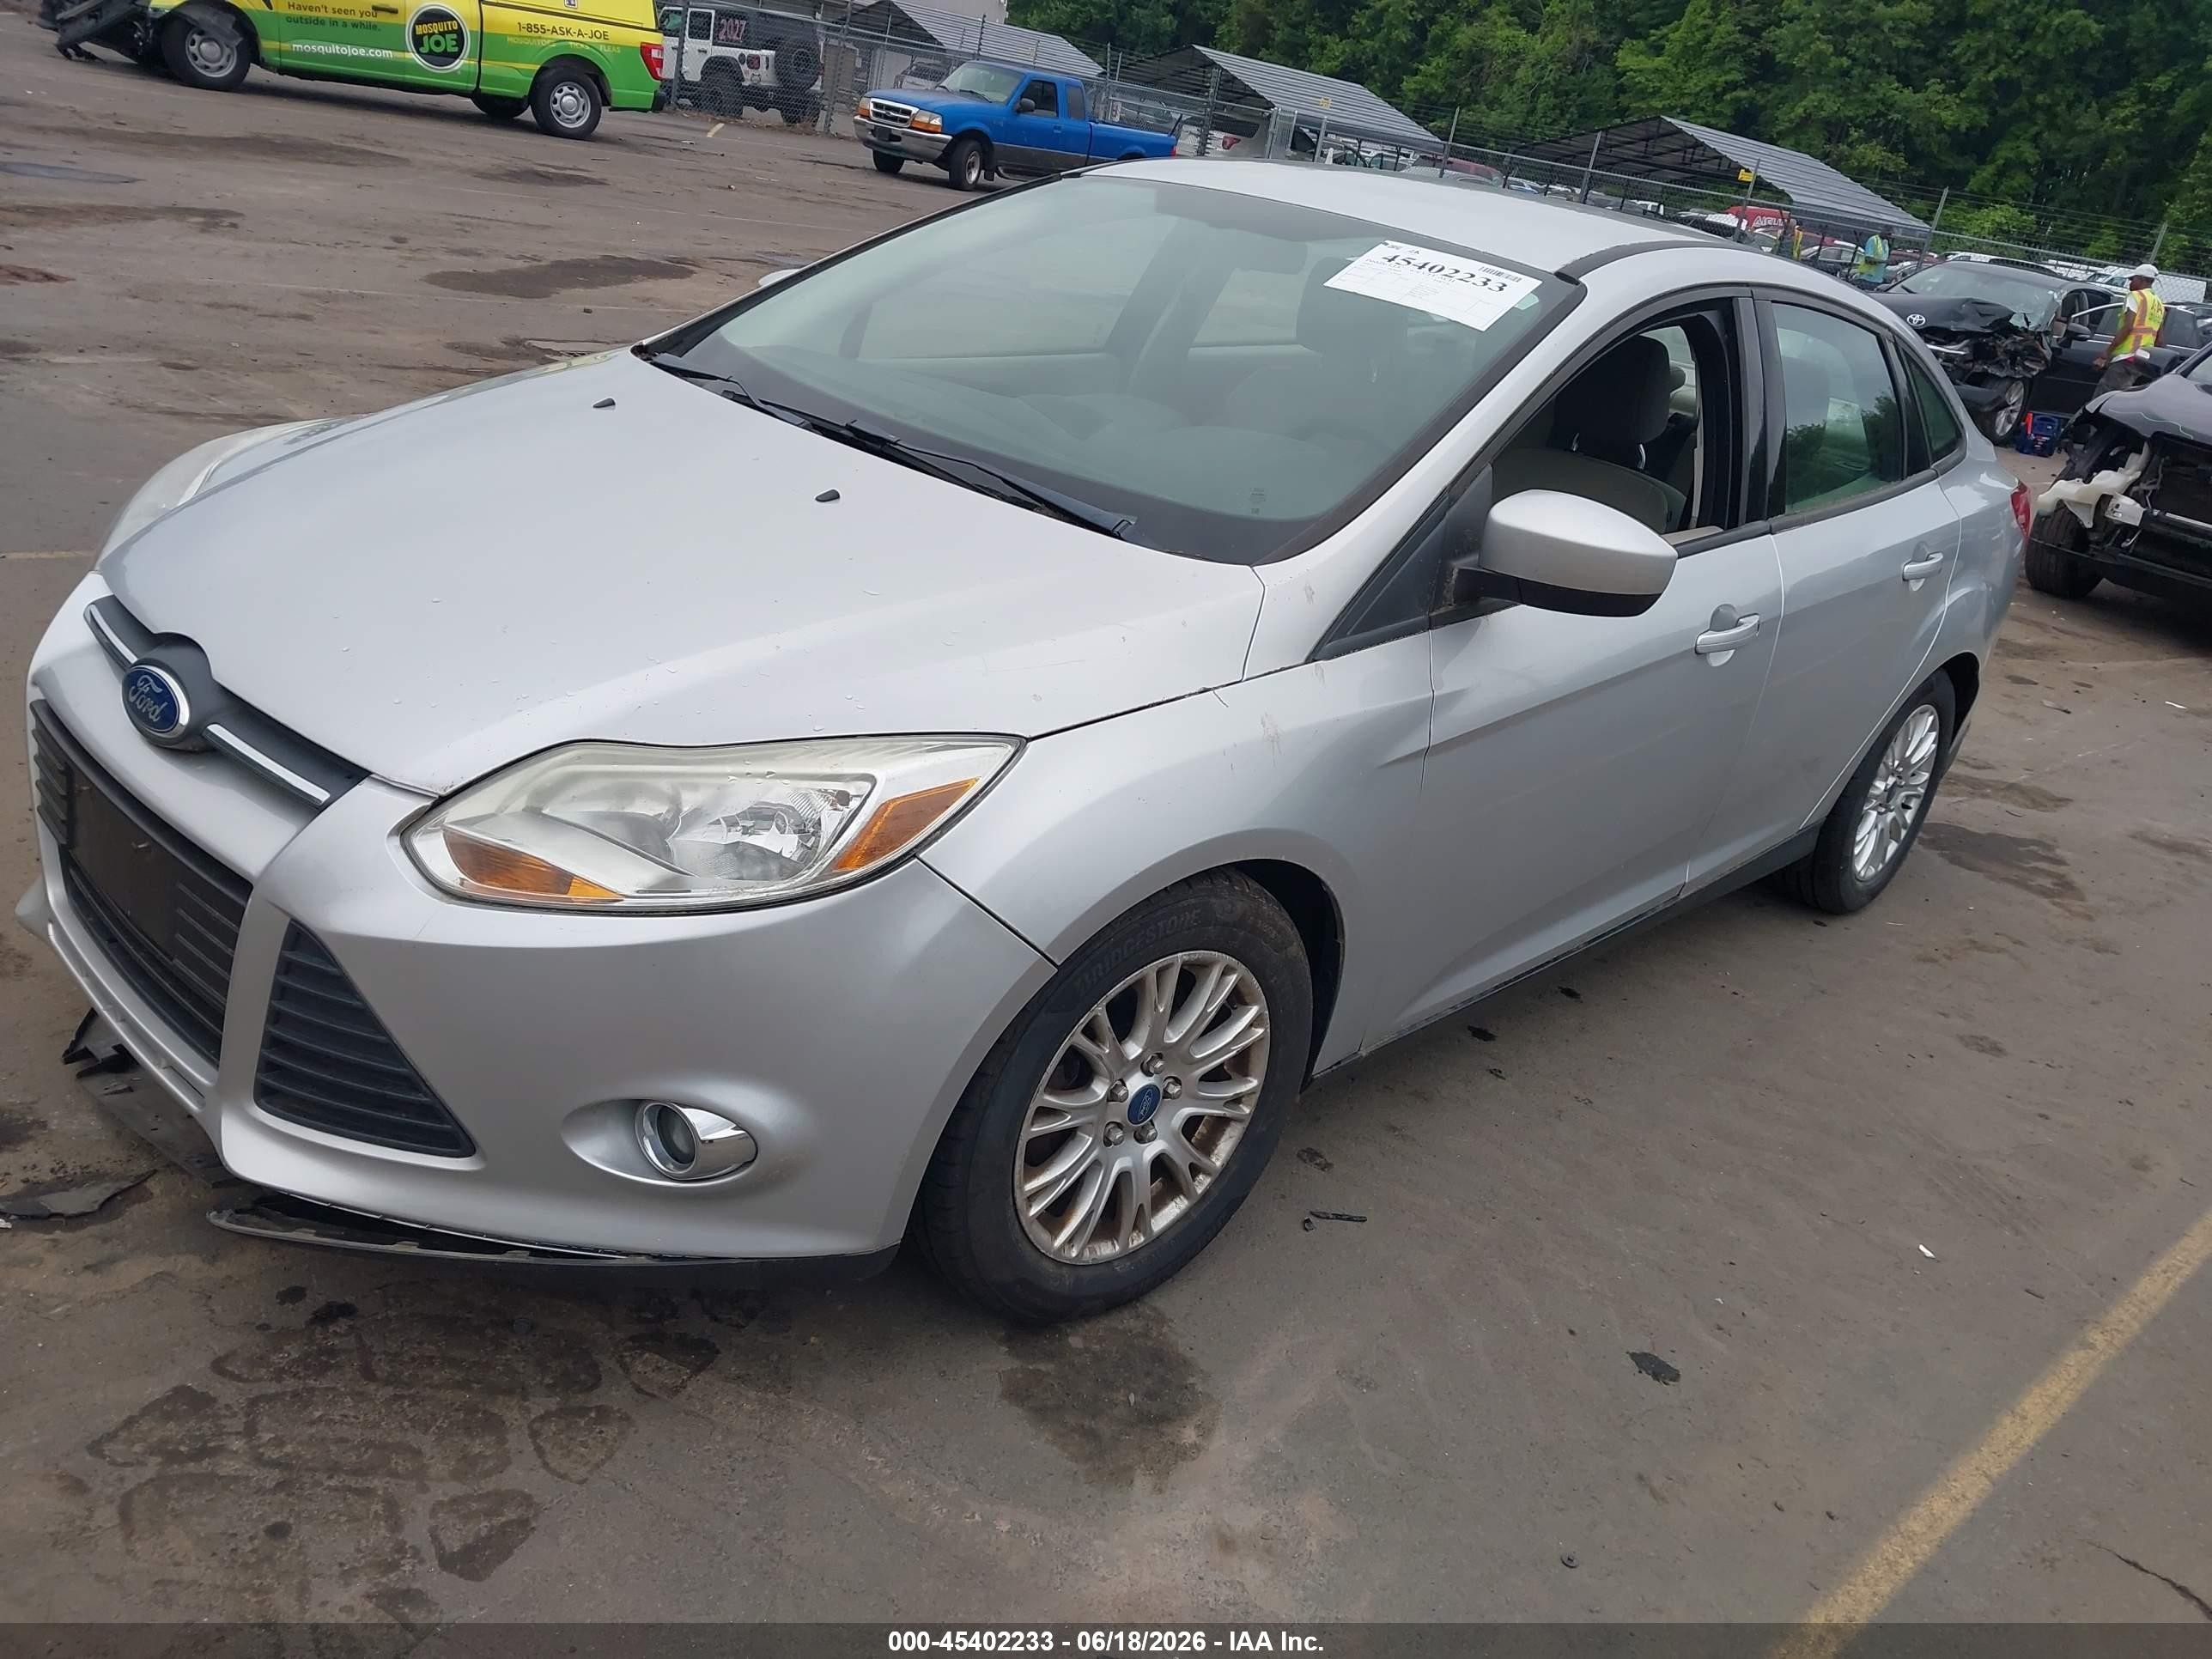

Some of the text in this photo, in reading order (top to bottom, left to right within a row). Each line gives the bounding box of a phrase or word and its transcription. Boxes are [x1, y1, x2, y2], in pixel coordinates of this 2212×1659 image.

[288, 2, 378, 19] Haven't seen you
[286, 15, 325, 27] outside
[329, 16, 339, 27] in
[350, 20, 381, 32] while.
[415, 20, 459, 35] MOSQUITO
[517, 21, 611, 40] 1-855-ASK-A-JOE
[292, 43, 393, 58] mosquitojoe.com
[419, 33, 459, 53] JOE
[1382, 253, 1508, 293] 45402233
[129, 675, 168, 721] Ford
